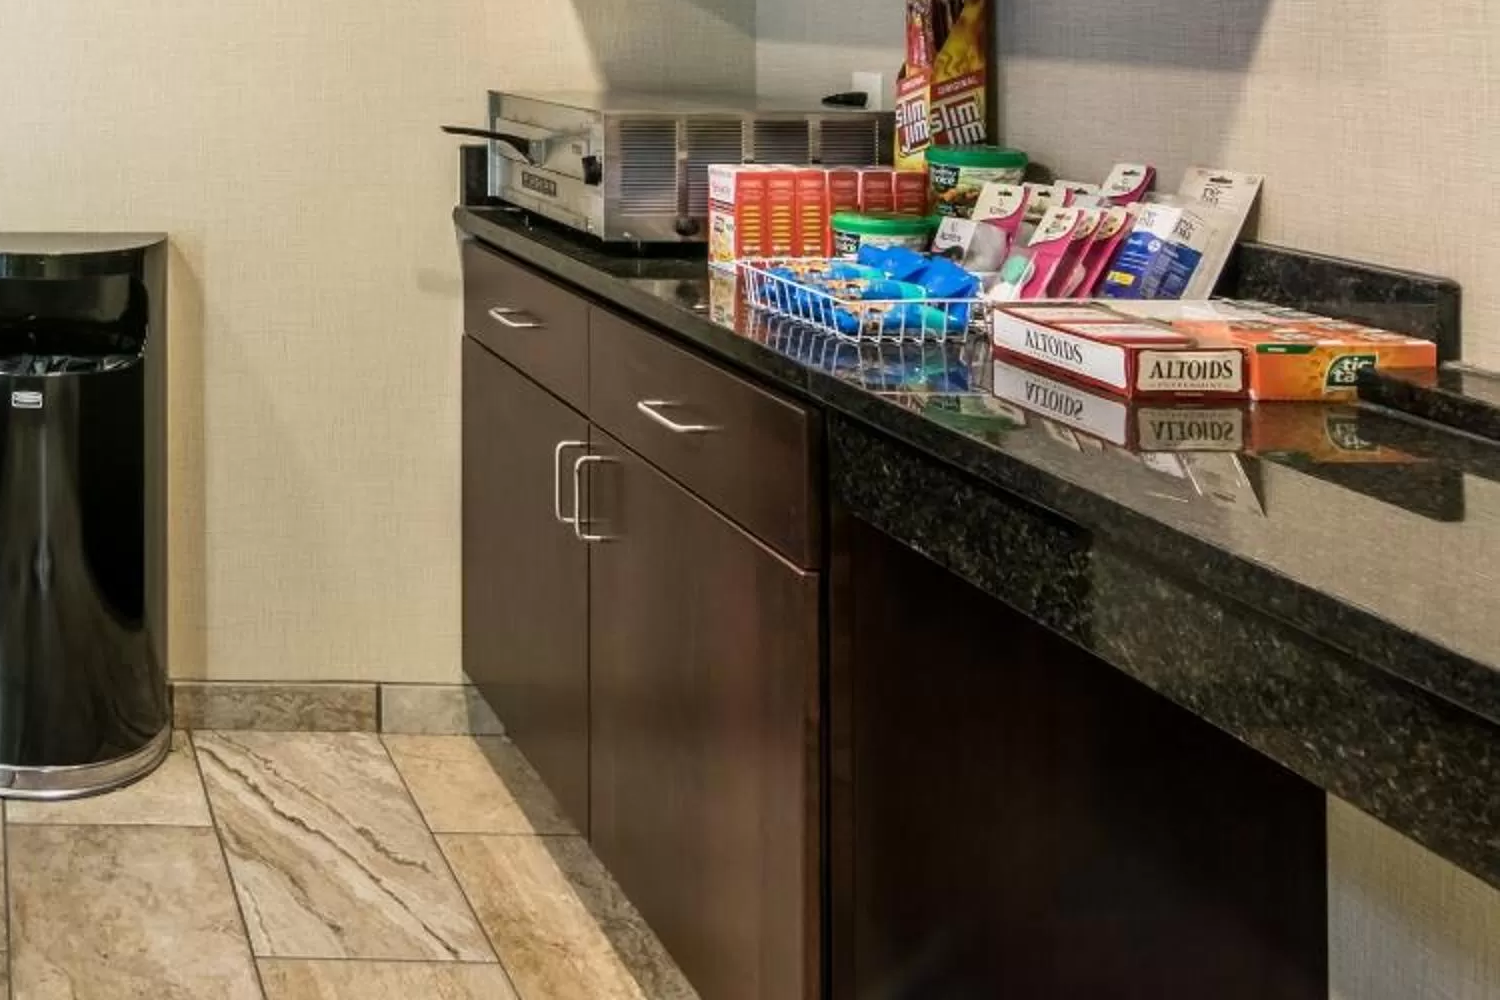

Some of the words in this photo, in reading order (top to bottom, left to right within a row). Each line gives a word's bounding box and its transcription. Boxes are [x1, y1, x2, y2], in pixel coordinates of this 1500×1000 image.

[1025, 327, 1083, 365] ALTOIDS
[1149, 359, 1233, 379] ALTOIDS
[1332, 368, 1358, 383] ta
